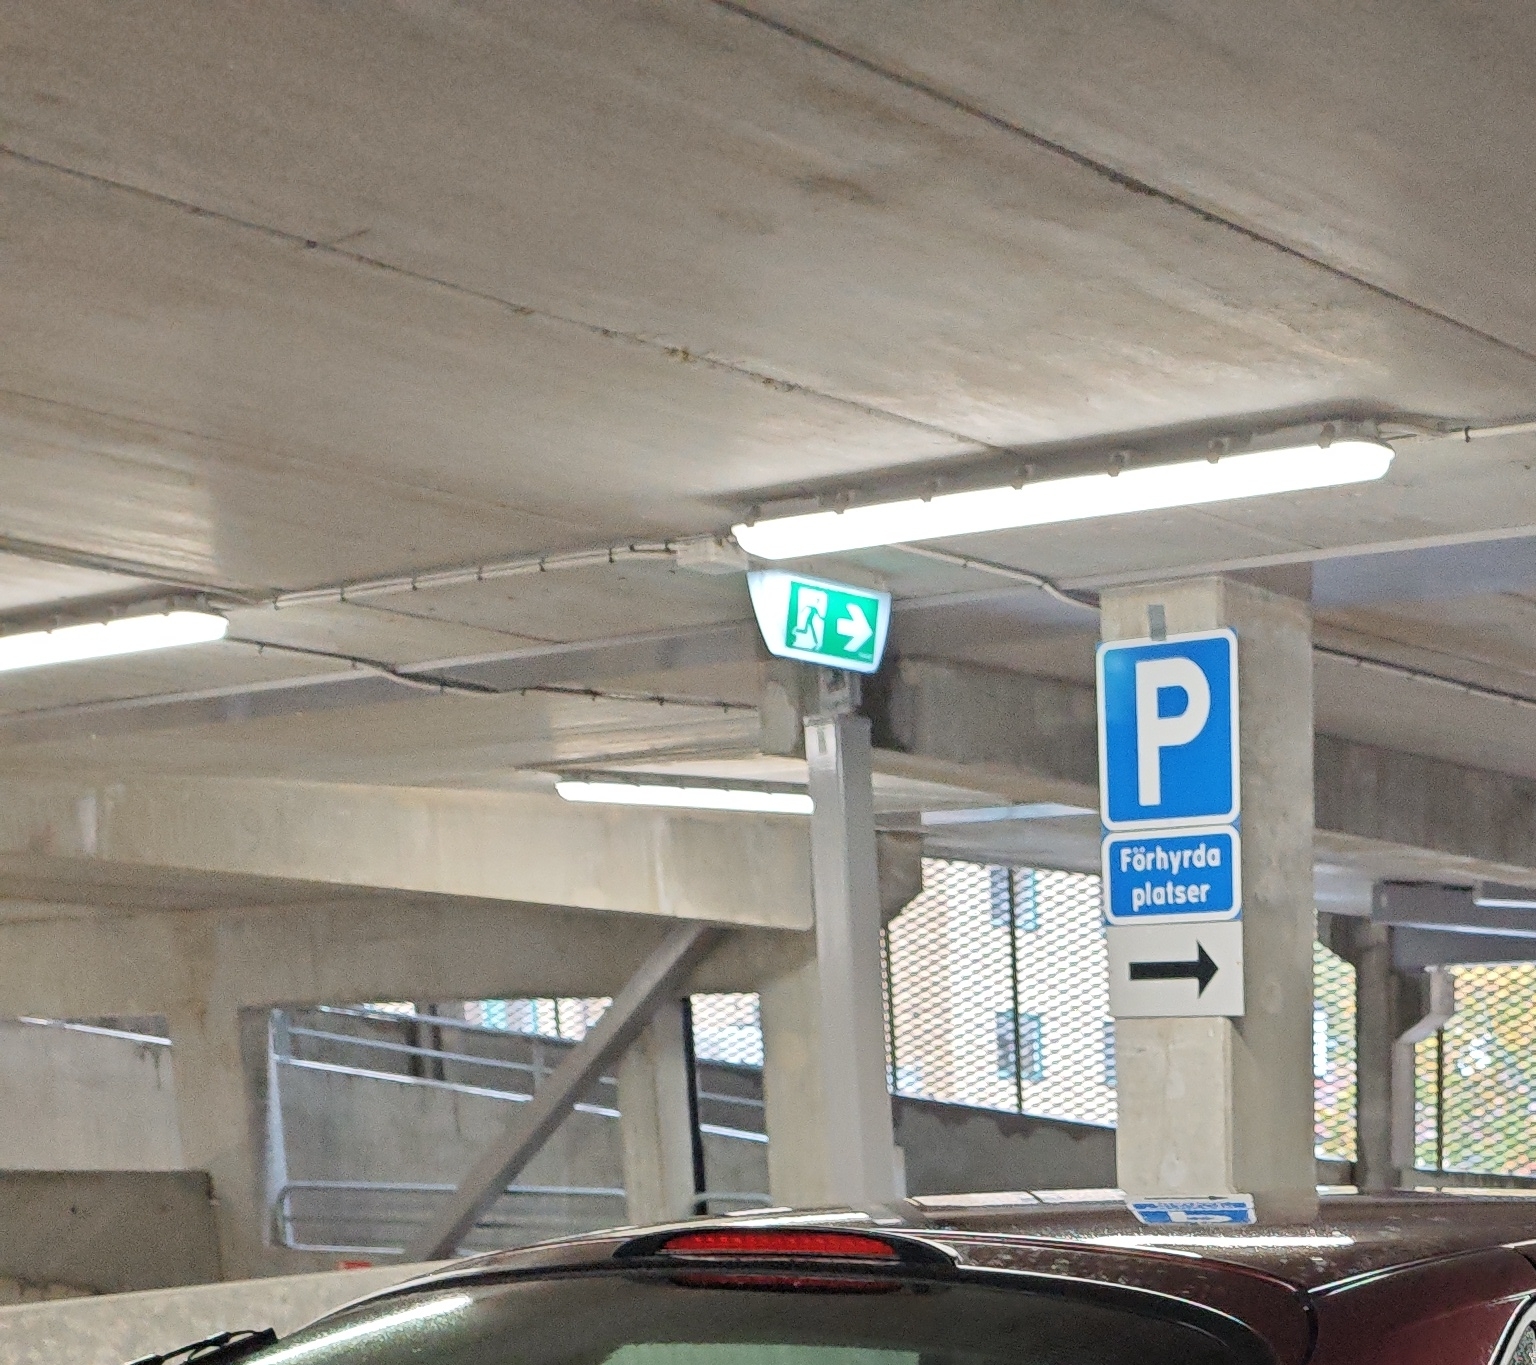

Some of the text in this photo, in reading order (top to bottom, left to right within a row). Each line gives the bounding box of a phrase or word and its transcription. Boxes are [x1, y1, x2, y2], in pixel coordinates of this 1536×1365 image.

[1135, 657, 1211, 807] P
[1120, 843, 1221, 875] Förhyrda
[1132, 881, 1211, 912] platser
